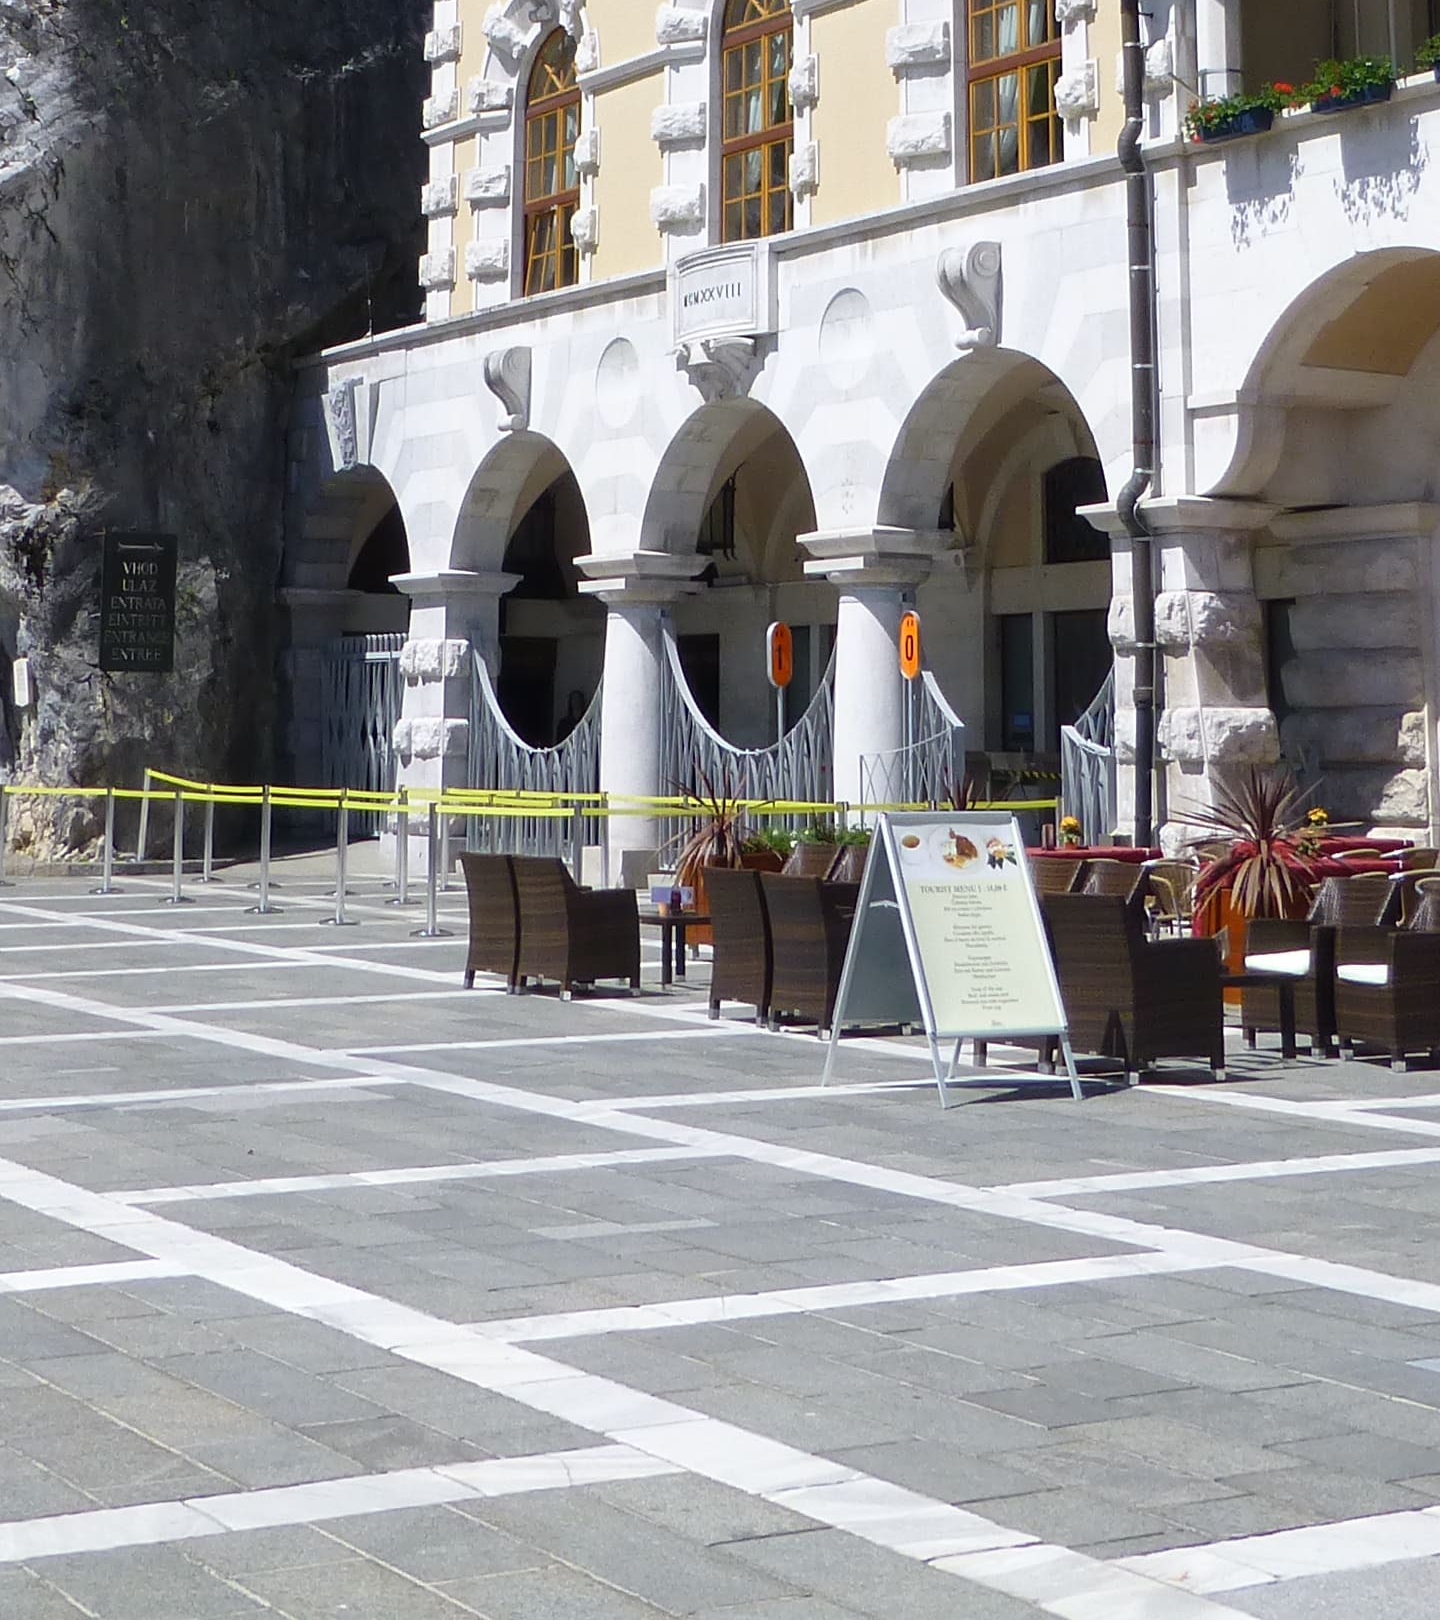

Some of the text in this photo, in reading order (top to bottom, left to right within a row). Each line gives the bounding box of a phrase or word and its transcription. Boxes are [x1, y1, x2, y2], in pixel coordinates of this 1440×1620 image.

[122, 561, 158, 575] VHOD
[122, 579, 157, 592] ULAZ
[111, 596, 166, 610] ENTRATA
[109, 613, 166, 627] EINTRITT
[905, 635, 914, 661] 0
[776, 644, 783, 670] 1
